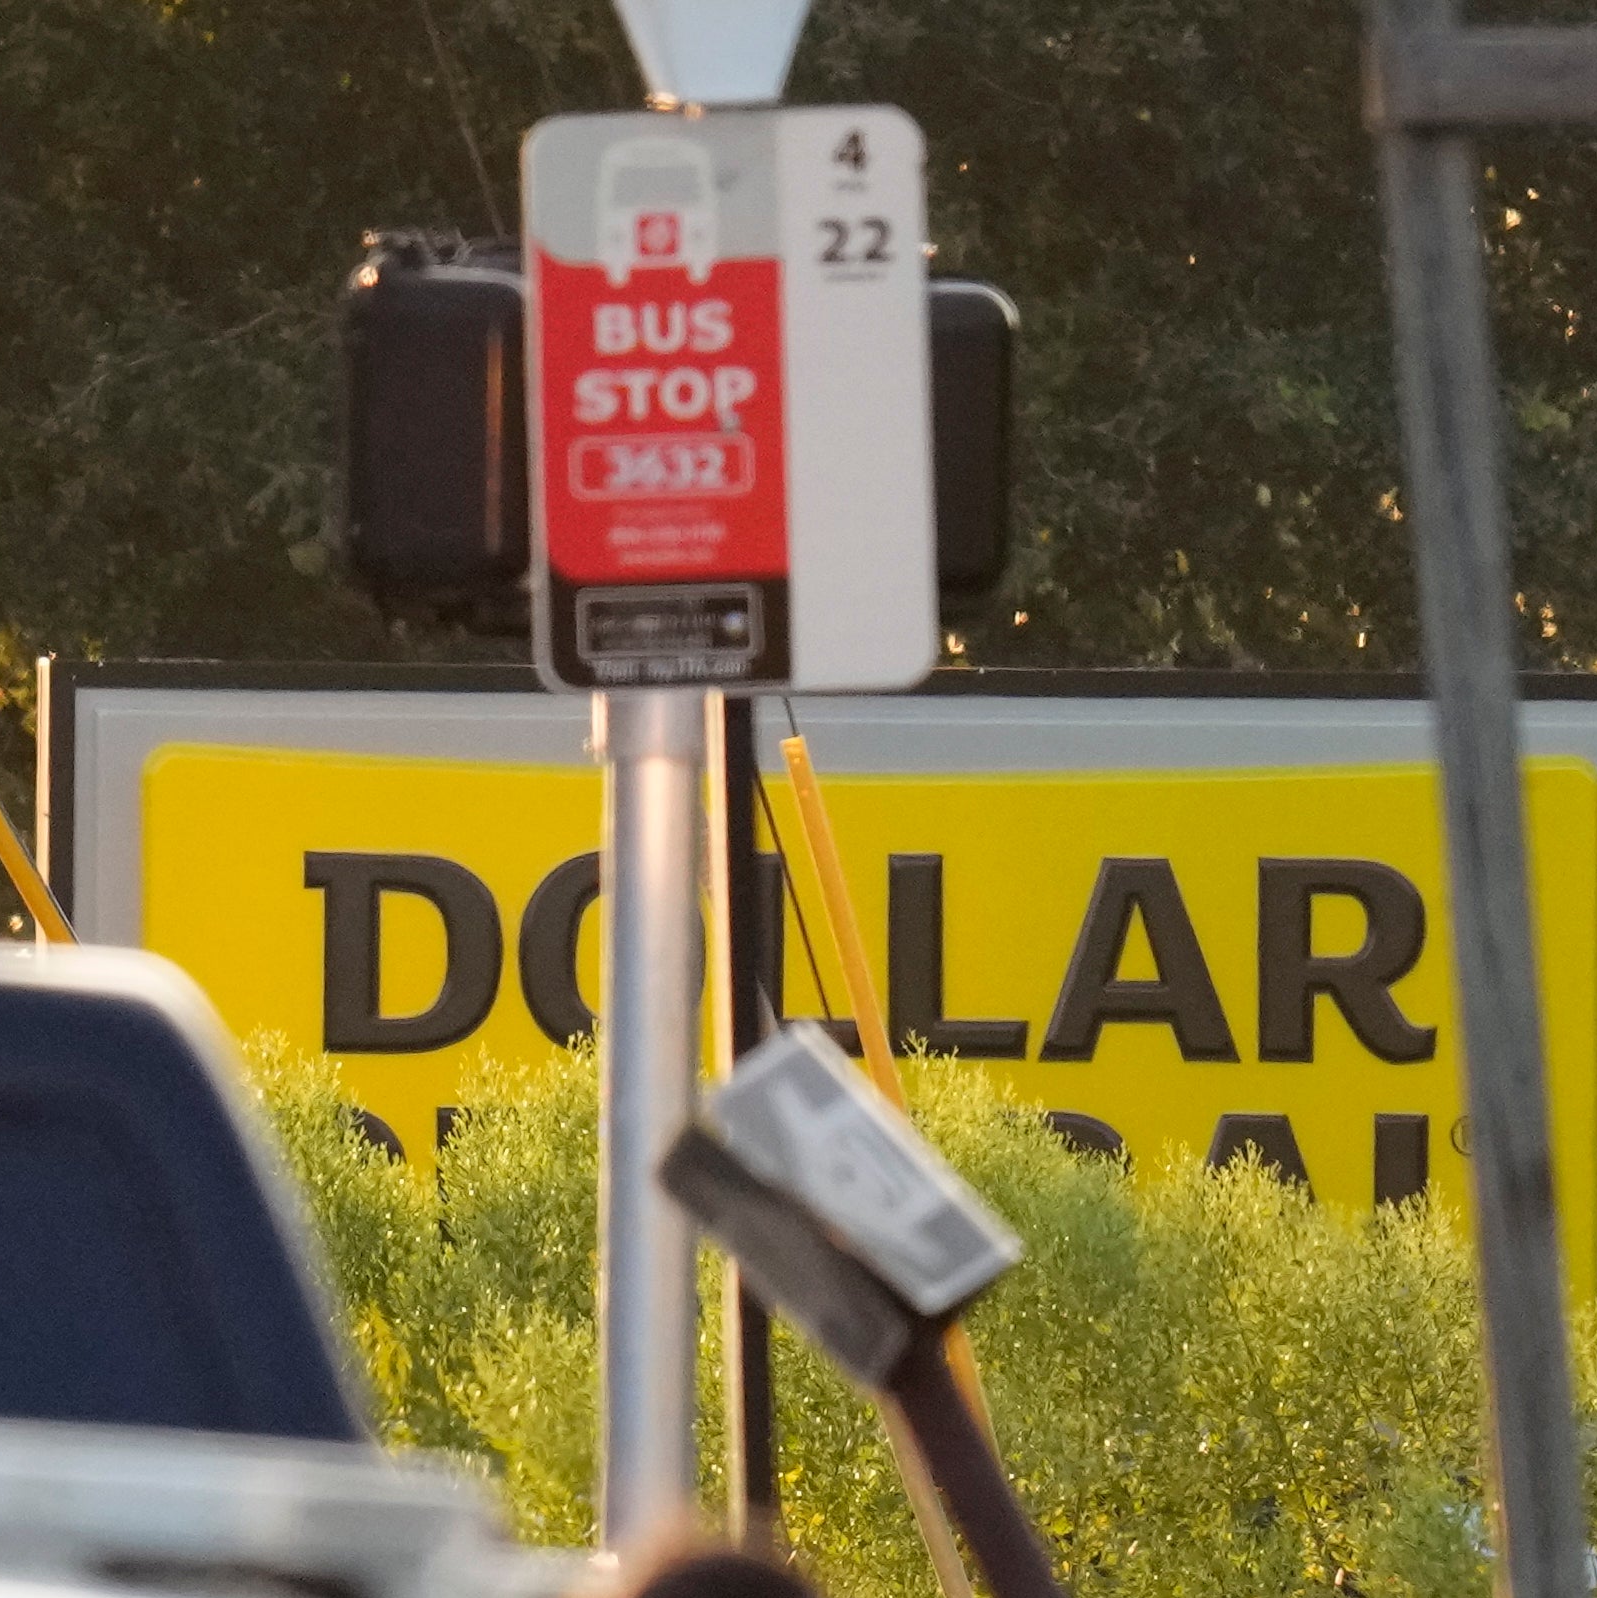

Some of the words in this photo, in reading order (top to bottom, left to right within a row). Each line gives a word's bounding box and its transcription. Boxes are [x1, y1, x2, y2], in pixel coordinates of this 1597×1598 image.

[832, 128, 868, 172] 4
[817, 216, 891, 265] 22
[593, 300, 735, 355] BUS
[574, 367, 758, 430] STOP
[609, 445, 725, 490] 3632
